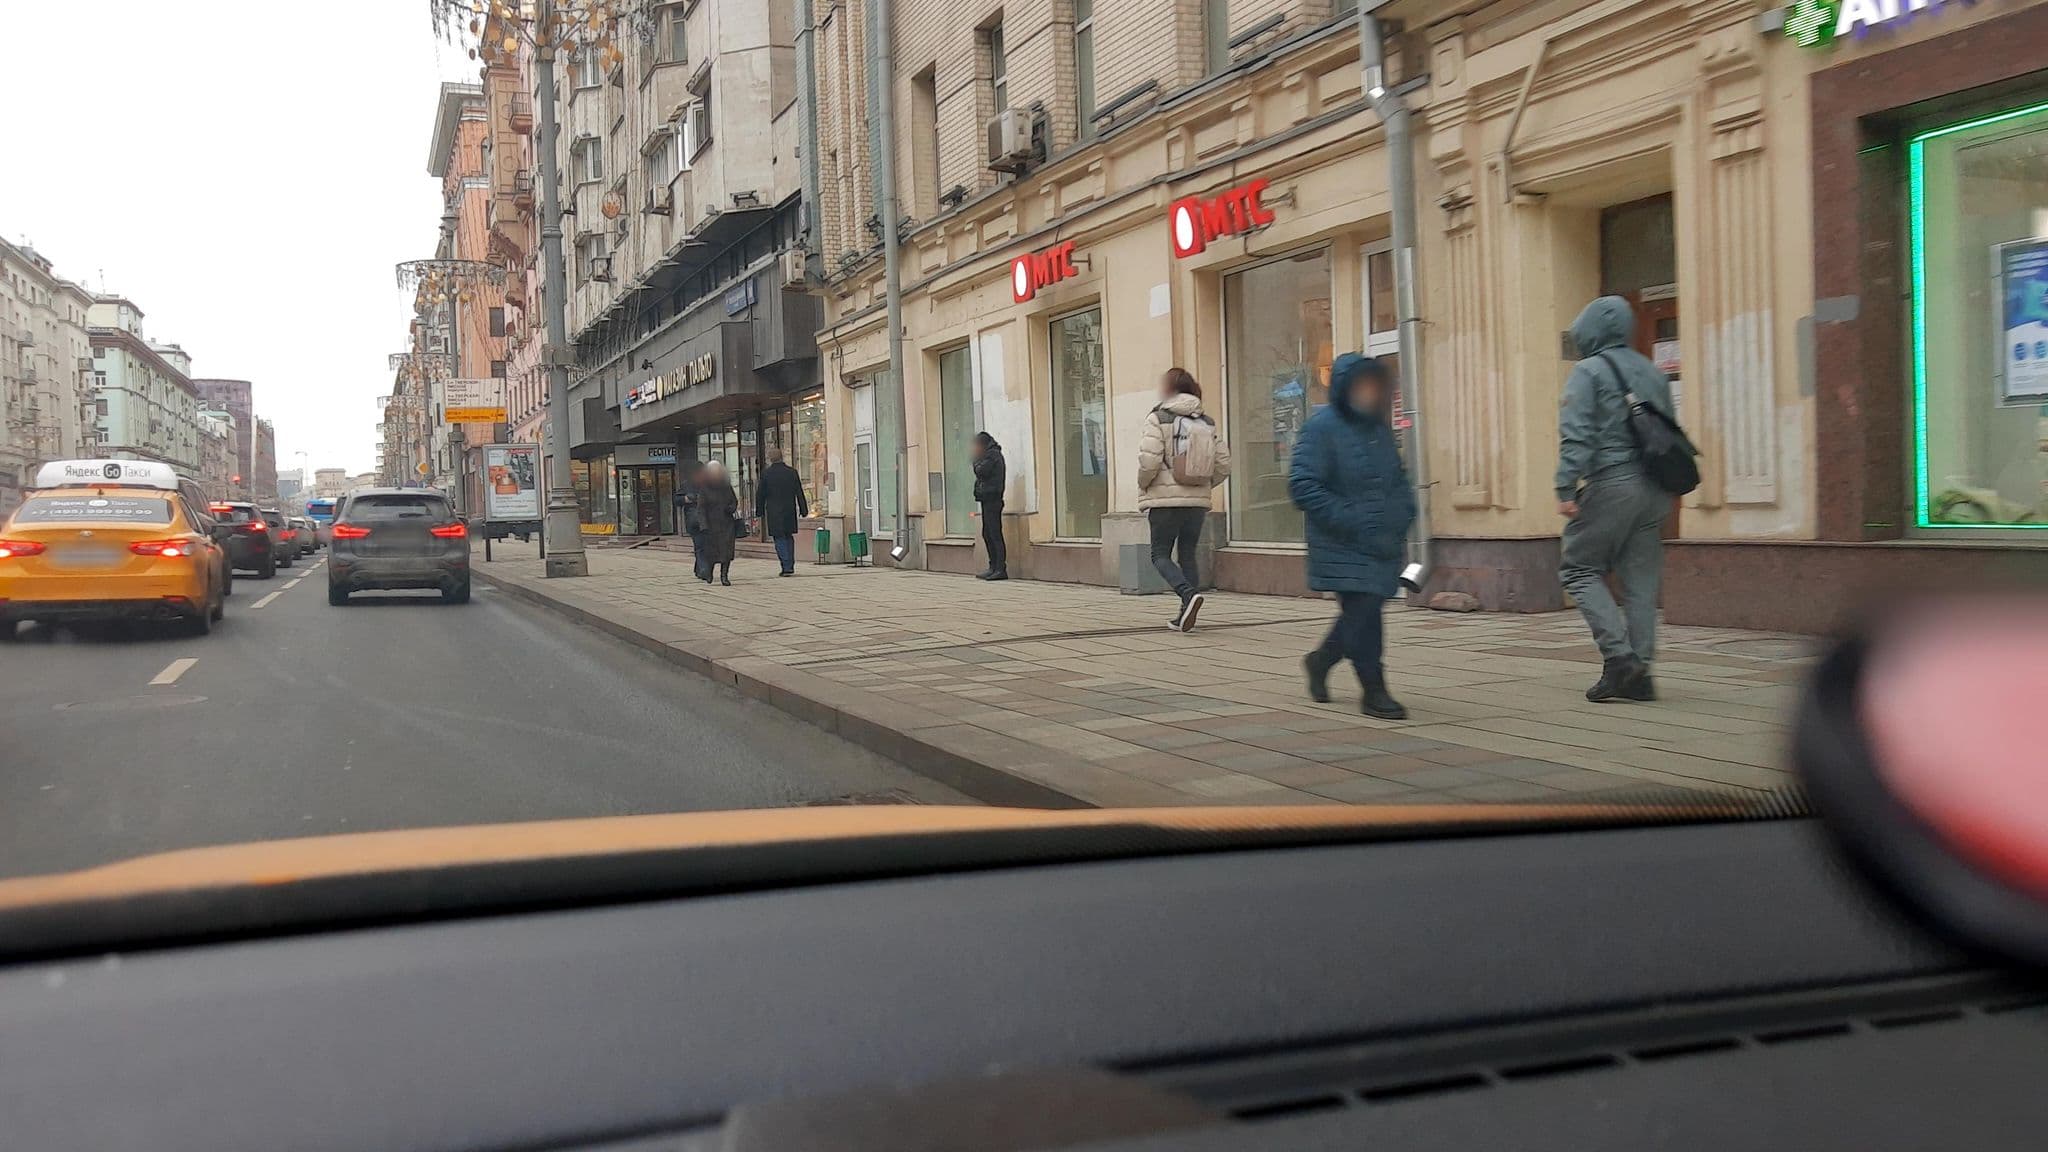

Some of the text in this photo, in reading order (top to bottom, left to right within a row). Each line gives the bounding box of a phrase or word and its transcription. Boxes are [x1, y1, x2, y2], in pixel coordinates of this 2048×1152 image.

[1201, 178, 1277, 243] МТС
[1032, 240, 1080, 290] МТС
[689, 352, 713, 385] ПАЛЬТО
[65, 465, 151, 478] Яндекс Go Такси
